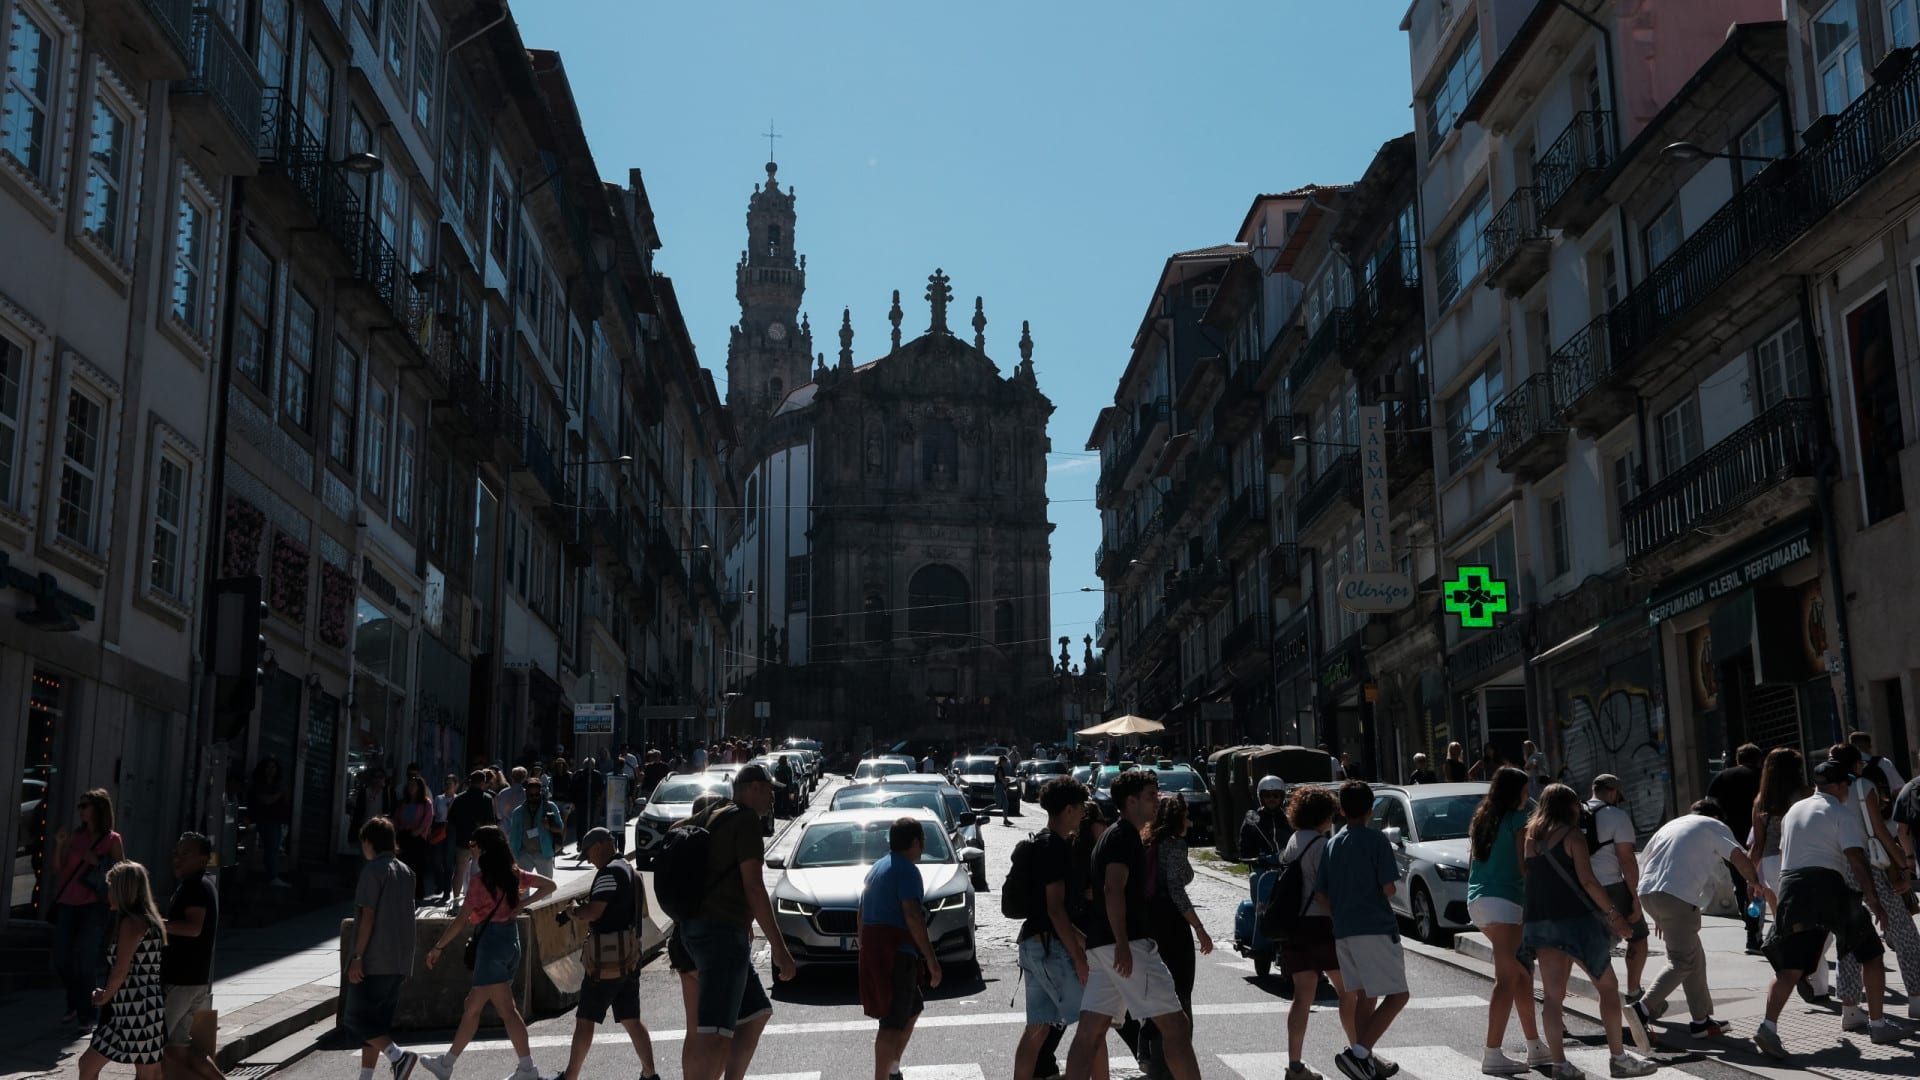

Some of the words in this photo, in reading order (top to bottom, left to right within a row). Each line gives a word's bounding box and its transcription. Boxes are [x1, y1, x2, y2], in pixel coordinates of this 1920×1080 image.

[1367, 416, 1387, 553] FARMÁCIA
[1345, 580, 1409, 605] Clérigos
[1649, 588, 1704, 623] PERFUMARIA
[1708, 571, 1743, 599] CLERIL
[1744, 537, 1812, 583] PERFUMARIA
